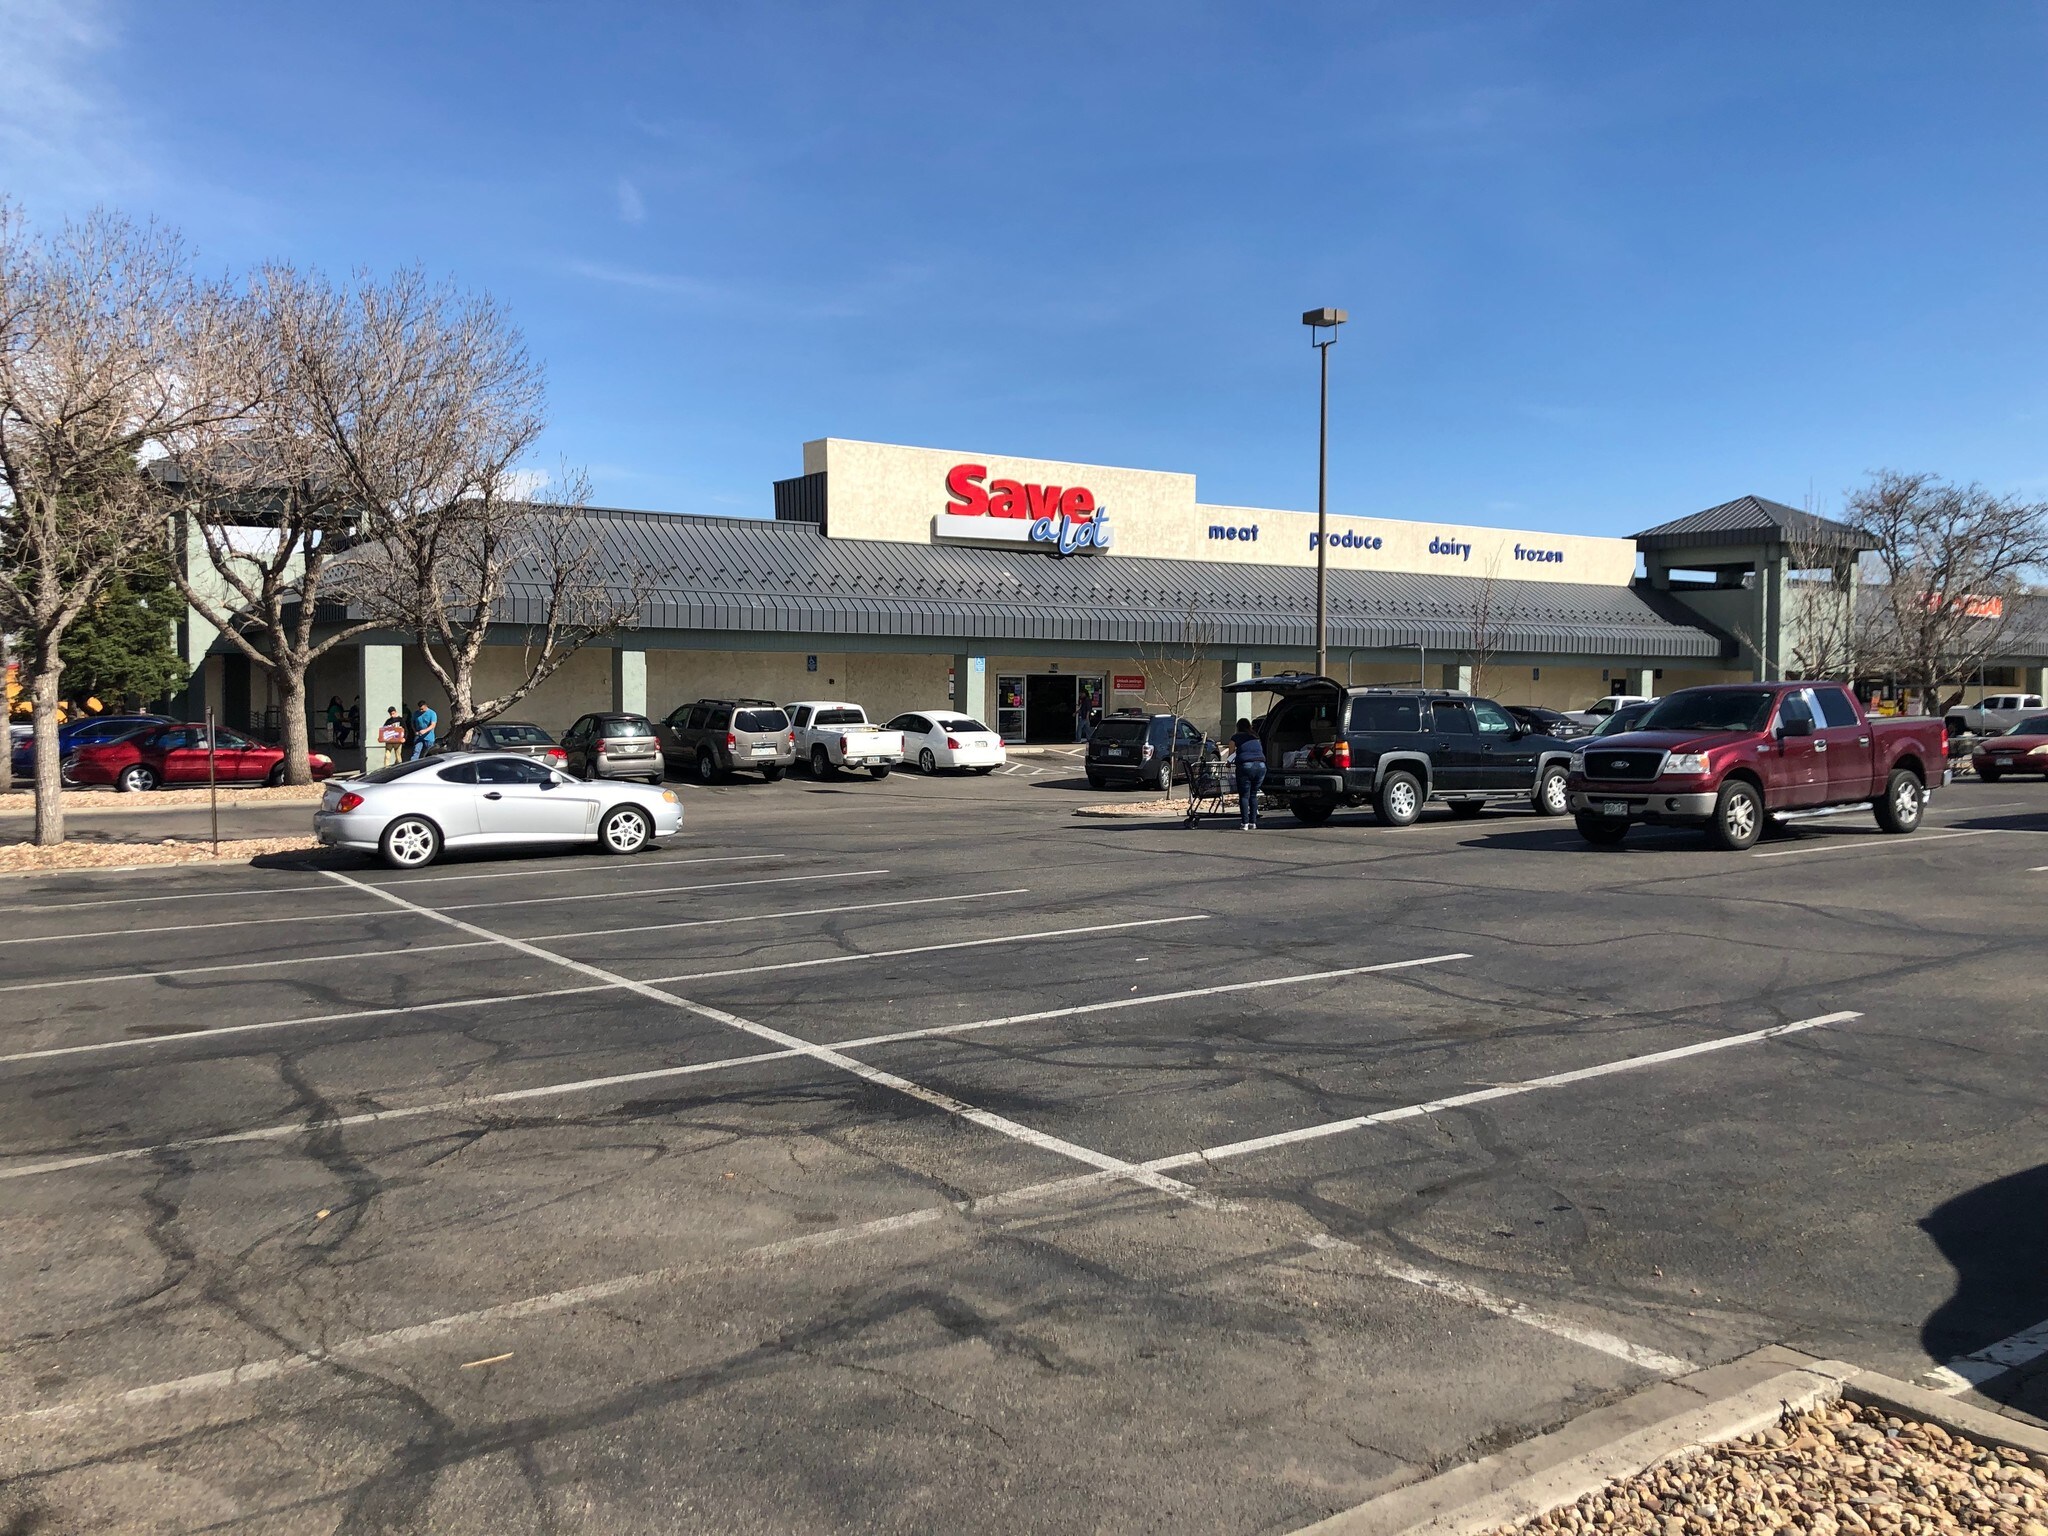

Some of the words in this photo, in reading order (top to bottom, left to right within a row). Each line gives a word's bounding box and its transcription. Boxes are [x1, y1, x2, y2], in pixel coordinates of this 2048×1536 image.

[945, 463, 1095, 525] Save
[1031, 515, 1060, 542] a
[1208, 524, 1260, 542] meat
[1309, 529, 1383, 551] poduce
[1428, 536, 1472, 562] dairy
[1513, 543, 1564, 563] frozen
